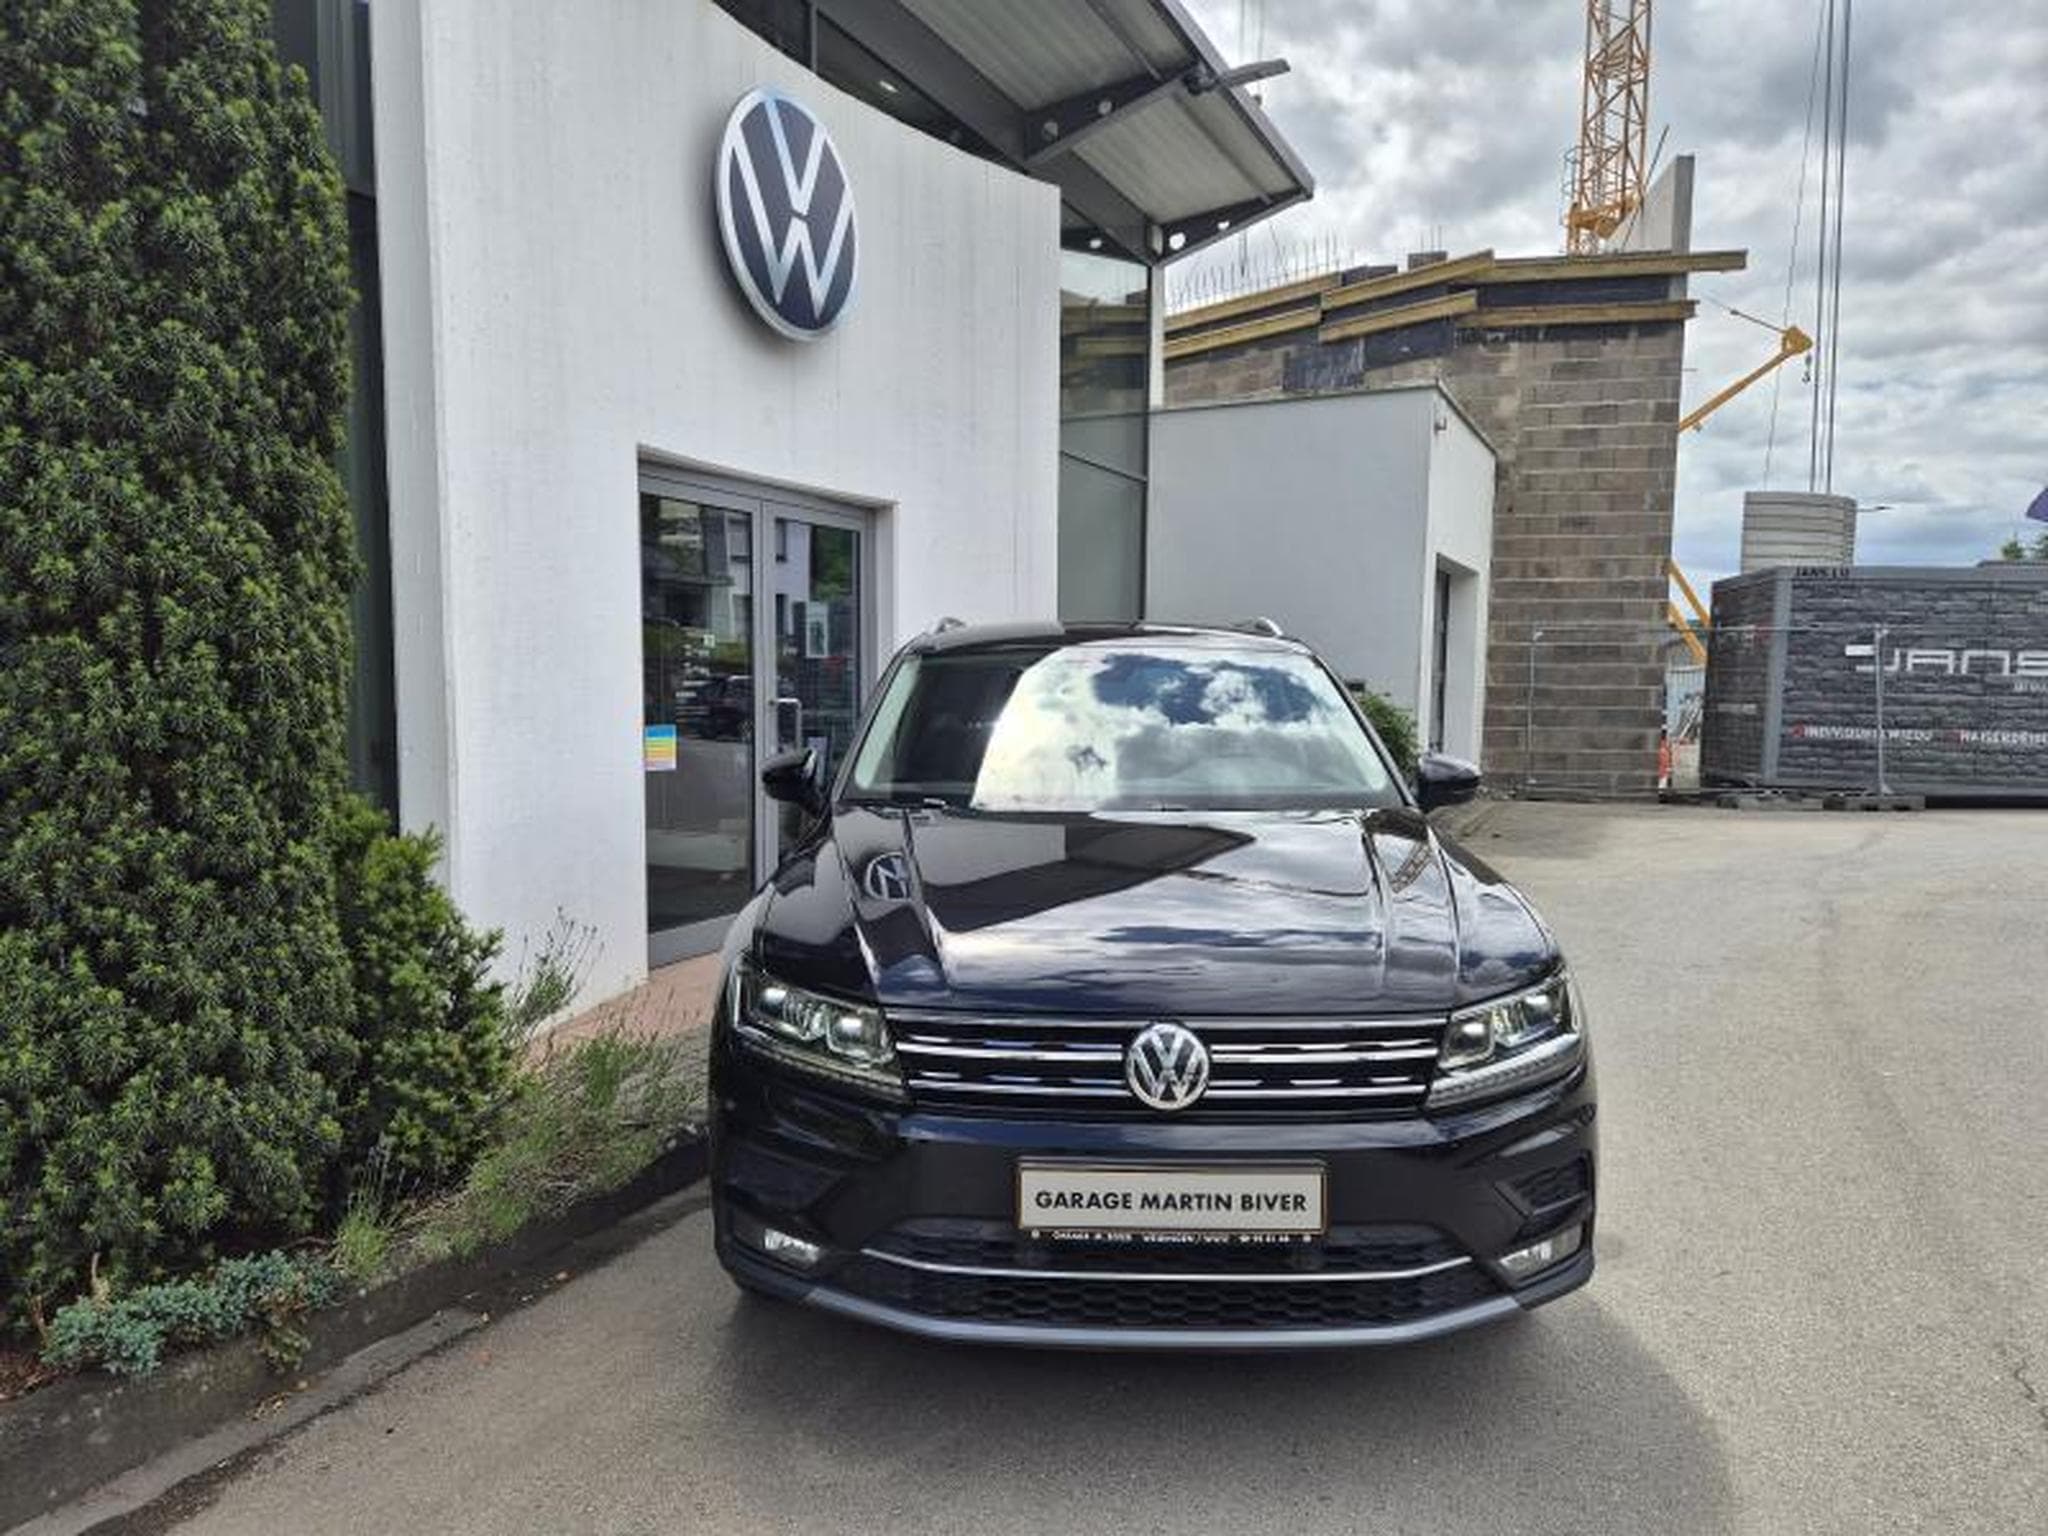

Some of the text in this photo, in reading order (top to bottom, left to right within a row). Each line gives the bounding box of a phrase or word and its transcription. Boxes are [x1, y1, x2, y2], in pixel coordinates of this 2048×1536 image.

[1035, 1191, 1308, 1212] GARAGE MARTIN BIVER
